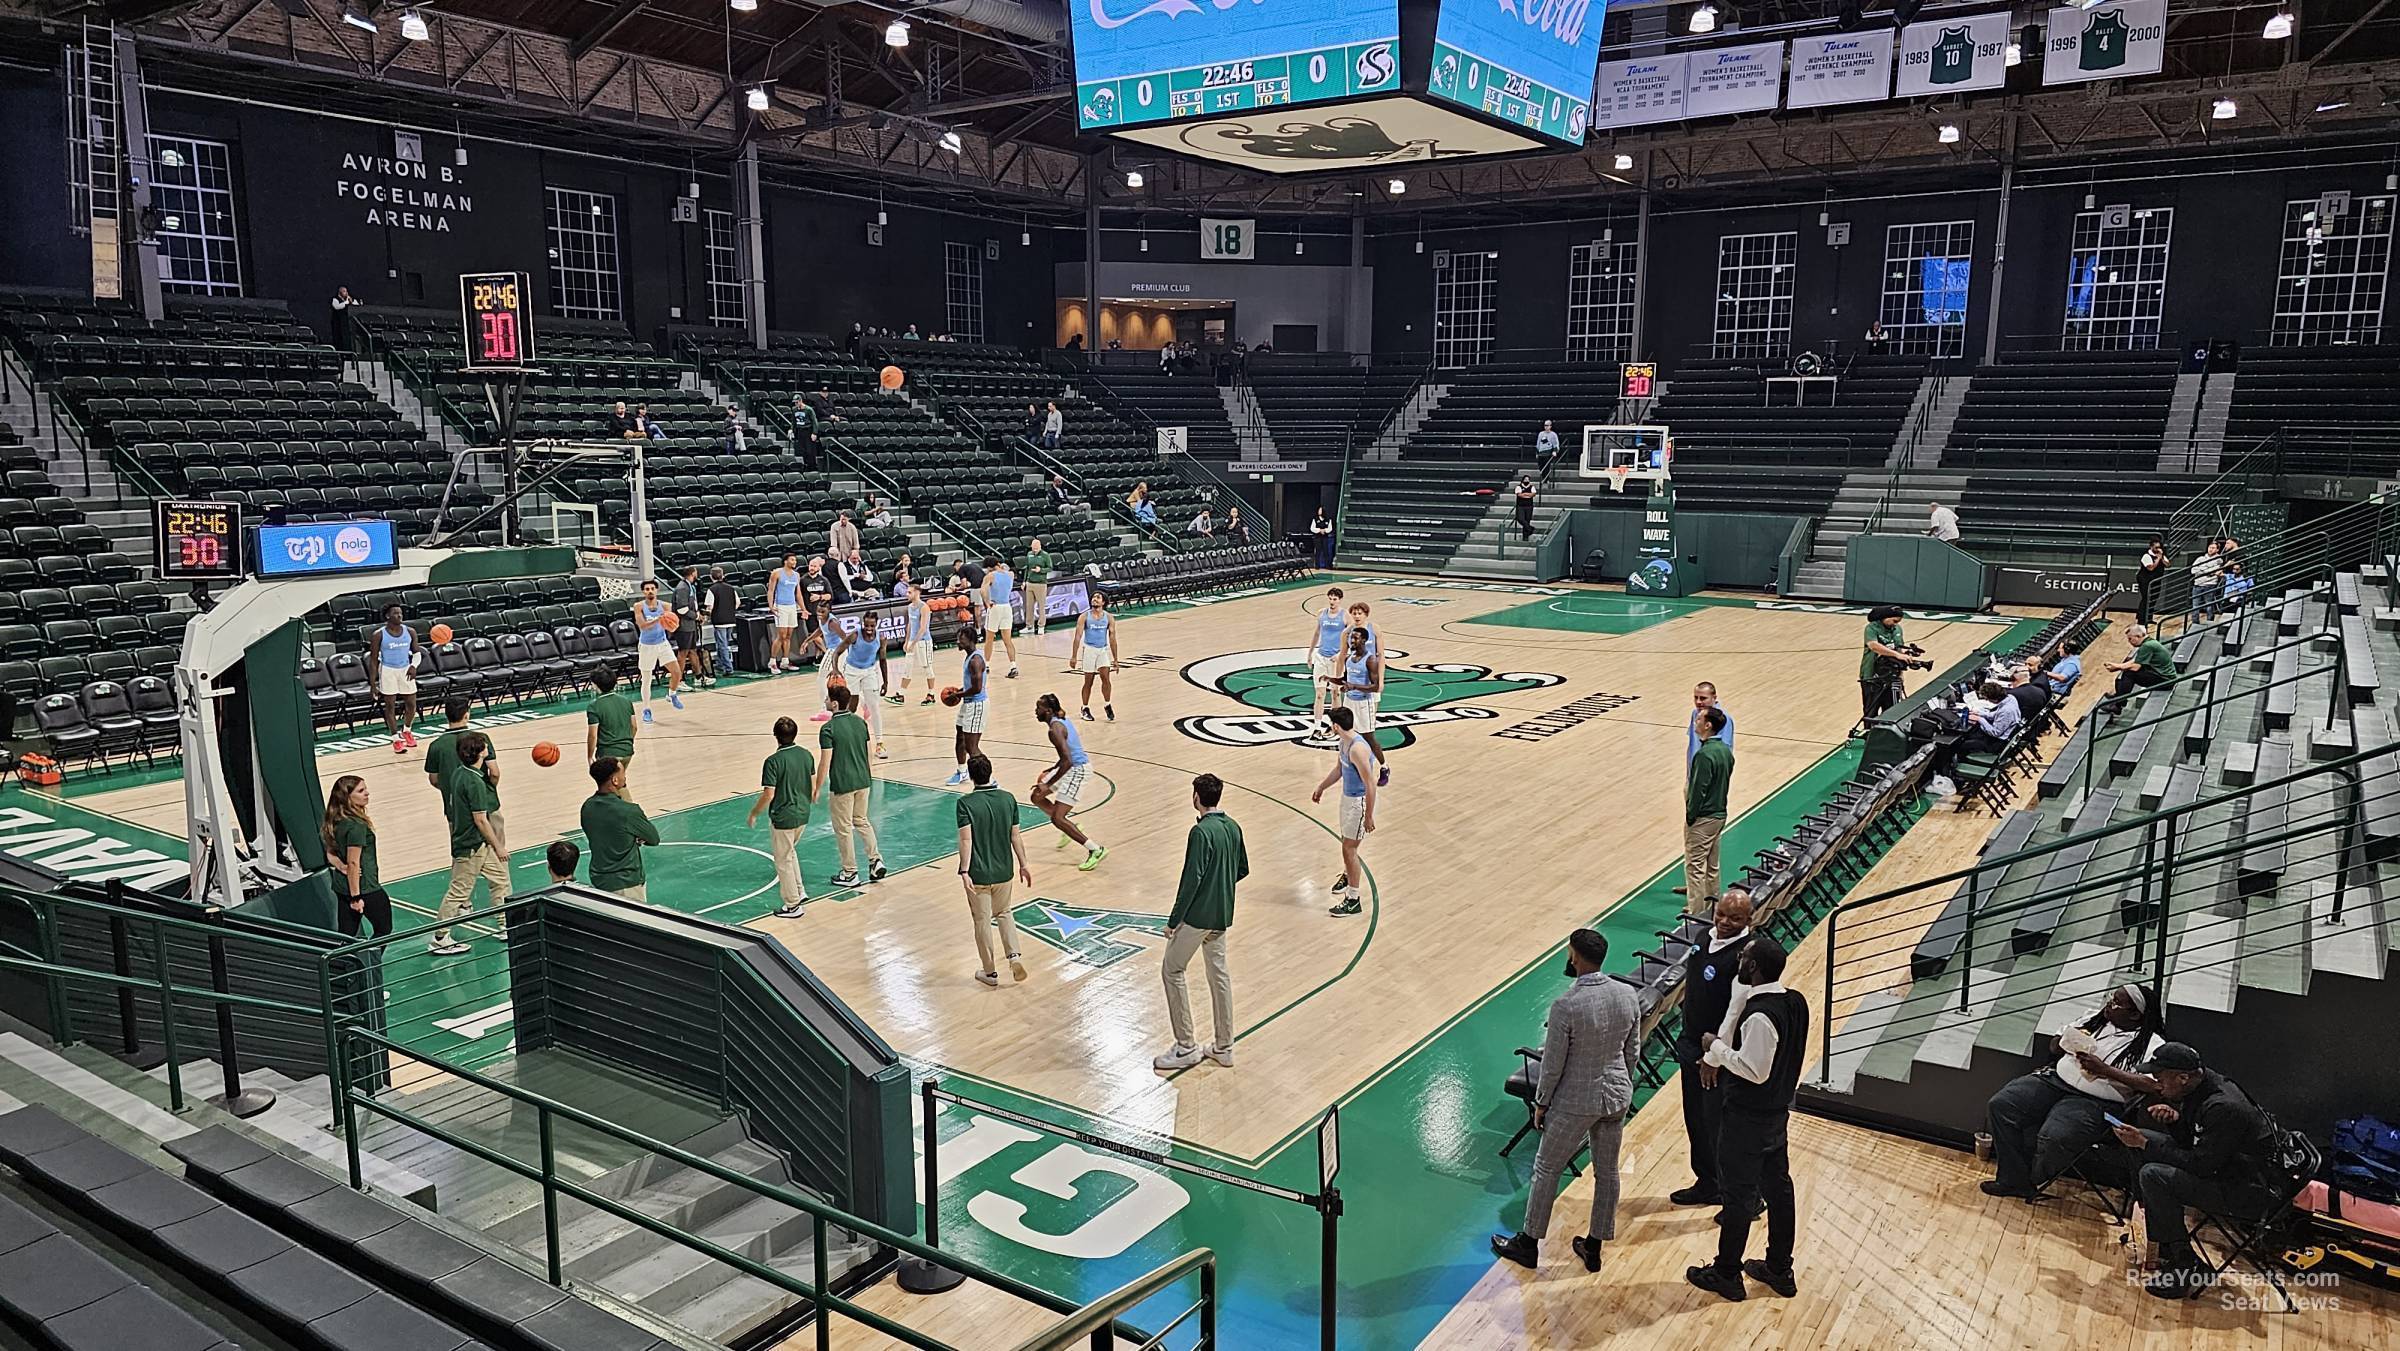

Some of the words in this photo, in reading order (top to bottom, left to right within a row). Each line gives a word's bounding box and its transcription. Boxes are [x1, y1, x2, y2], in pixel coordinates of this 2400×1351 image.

[2051, 36, 2077, 51] 1996
[2099, 35, 2109, 51] 4
[2129, 26, 2160, 42] 2000
[1808, 55, 1835, 64] WOMEN'S
[1837, 51, 1873, 61] BASKETBALL
[1905, 51, 1929, 65] 1983
[1946, 50, 1960, 66] 10
[1977, 43, 2002, 57] 1987
[1309, 55, 1327, 83] 0
[1703, 67, 1728, 76] WOMEN'S
[1730, 64, 1764, 73] BASKETBALL
[1805, 62, 1839, 71] CONFERENCE
[1841, 58, 1875, 68] CHAMPIONS
[1202, 62, 1254, 87] 22:46
[1468, 62, 1479, 90] 0
[1639, 75, 1670, 84] BASKETBALL
[1699, 74, 1733, 83] TOURNAMENT
[1735, 71, 1767, 79] CHAMPIONS
[1138, 80, 1153, 106] 0
[1257, 81, 1274, 93] FLS
[1281, 80, 1288, 89] 0
[1503, 73, 1530, 99] 22:46
[1632, 83, 1666, 92] TOURNAMENT
[1173, 94, 1188, 104] FLS
[1193, 92, 1201, 101] 0
[1217, 92, 1240, 107] 1ST
[1258, 95, 1273, 105] TO
[1173, 106, 1186, 117] TO
[1507, 103, 1520, 118] 1ST
[1551, 96, 1561, 121] 0
[402, 142, 417, 158] A
[343, 153, 427, 180] AVRON
[441, 166, 463, 184] B.
[337, 180, 472, 212] FOGELMAN
[683, 206, 692, 219] B
[2328, 199, 2341, 213] H
[366, 208, 450, 232] ARENA
[2110, 212, 2122, 225] G
[872, 230, 880, 244] C
[1214, 225, 1241, 254] 18
[1835, 230, 1843, 242] F
[990, 247, 997, 258] D
[1598, 246, 1605, 258] E
[1437, 255, 1445, 267] D
[1131, 283, 1169, 292] PREMIUM
[1170, 284, 1191, 292] CLUB
[473, 284, 517, 311] 22:46
[482, 312, 516, 358] 30
[1625, 366, 1653, 377] 22:46
[1627, 377, 1650, 396] 30
[168, 512, 228, 534] 22:46
[1646, 510, 1669, 522] ROLL
[1643, 529, 1670, 541] WAVE
[341, 538, 368, 549] nola
[181, 538, 219, 566] 30
[1489, 692, 1642, 742] FIELDHOUSE
[1076, 1133, 1097, 1145] KEEP
[1098, 1138, 1121, 1152] YOUR
[1122, 1144, 1165, 1165] DISTANCE
